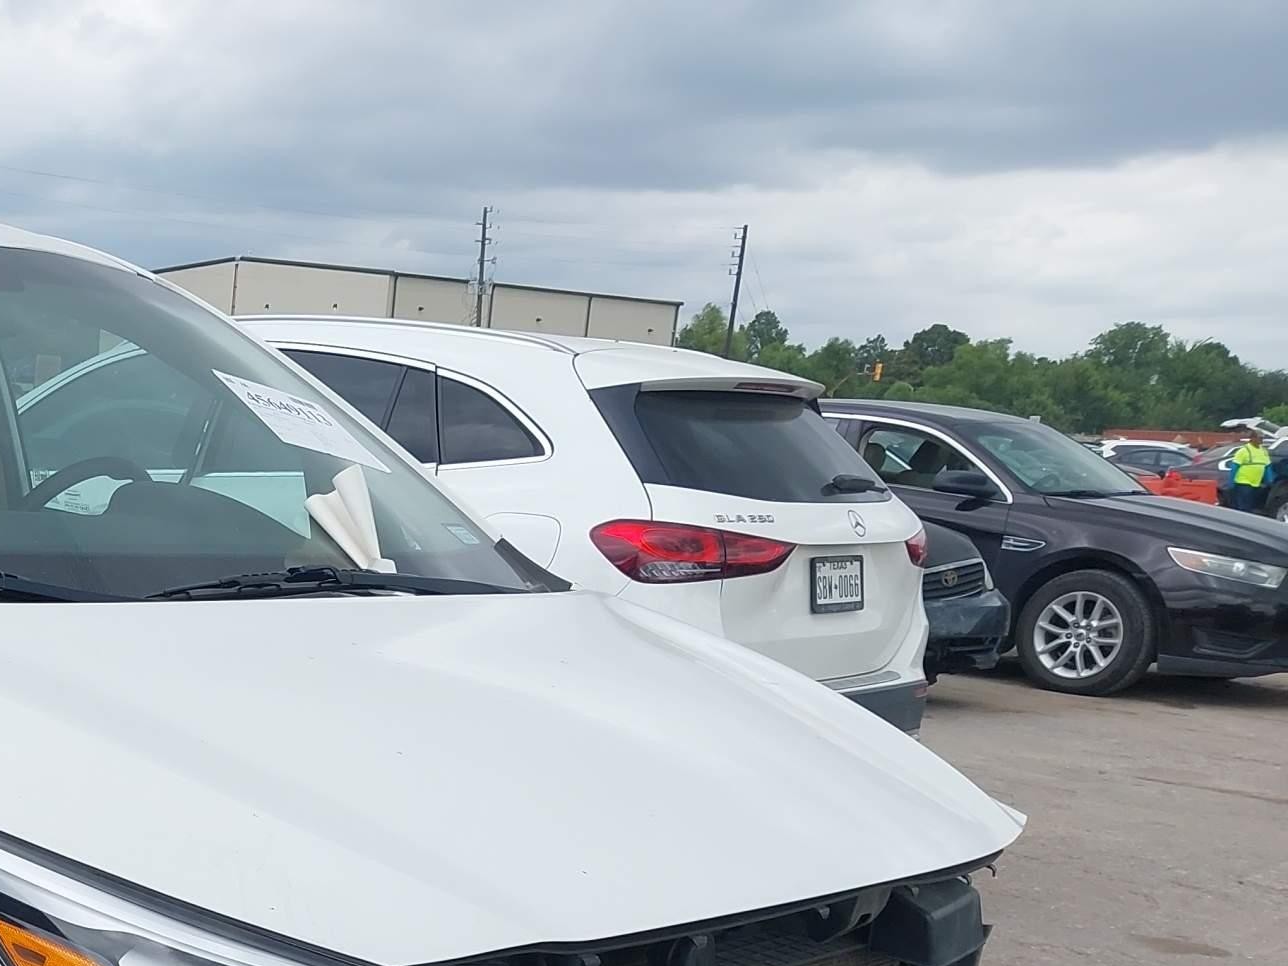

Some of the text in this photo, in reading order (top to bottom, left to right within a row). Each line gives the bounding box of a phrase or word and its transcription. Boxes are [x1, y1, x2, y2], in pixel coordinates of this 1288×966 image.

[246, 391, 333, 427] 45649113
[715, 513, 775, 524] GLA 250
[829, 561, 848, 571] TEXAS
